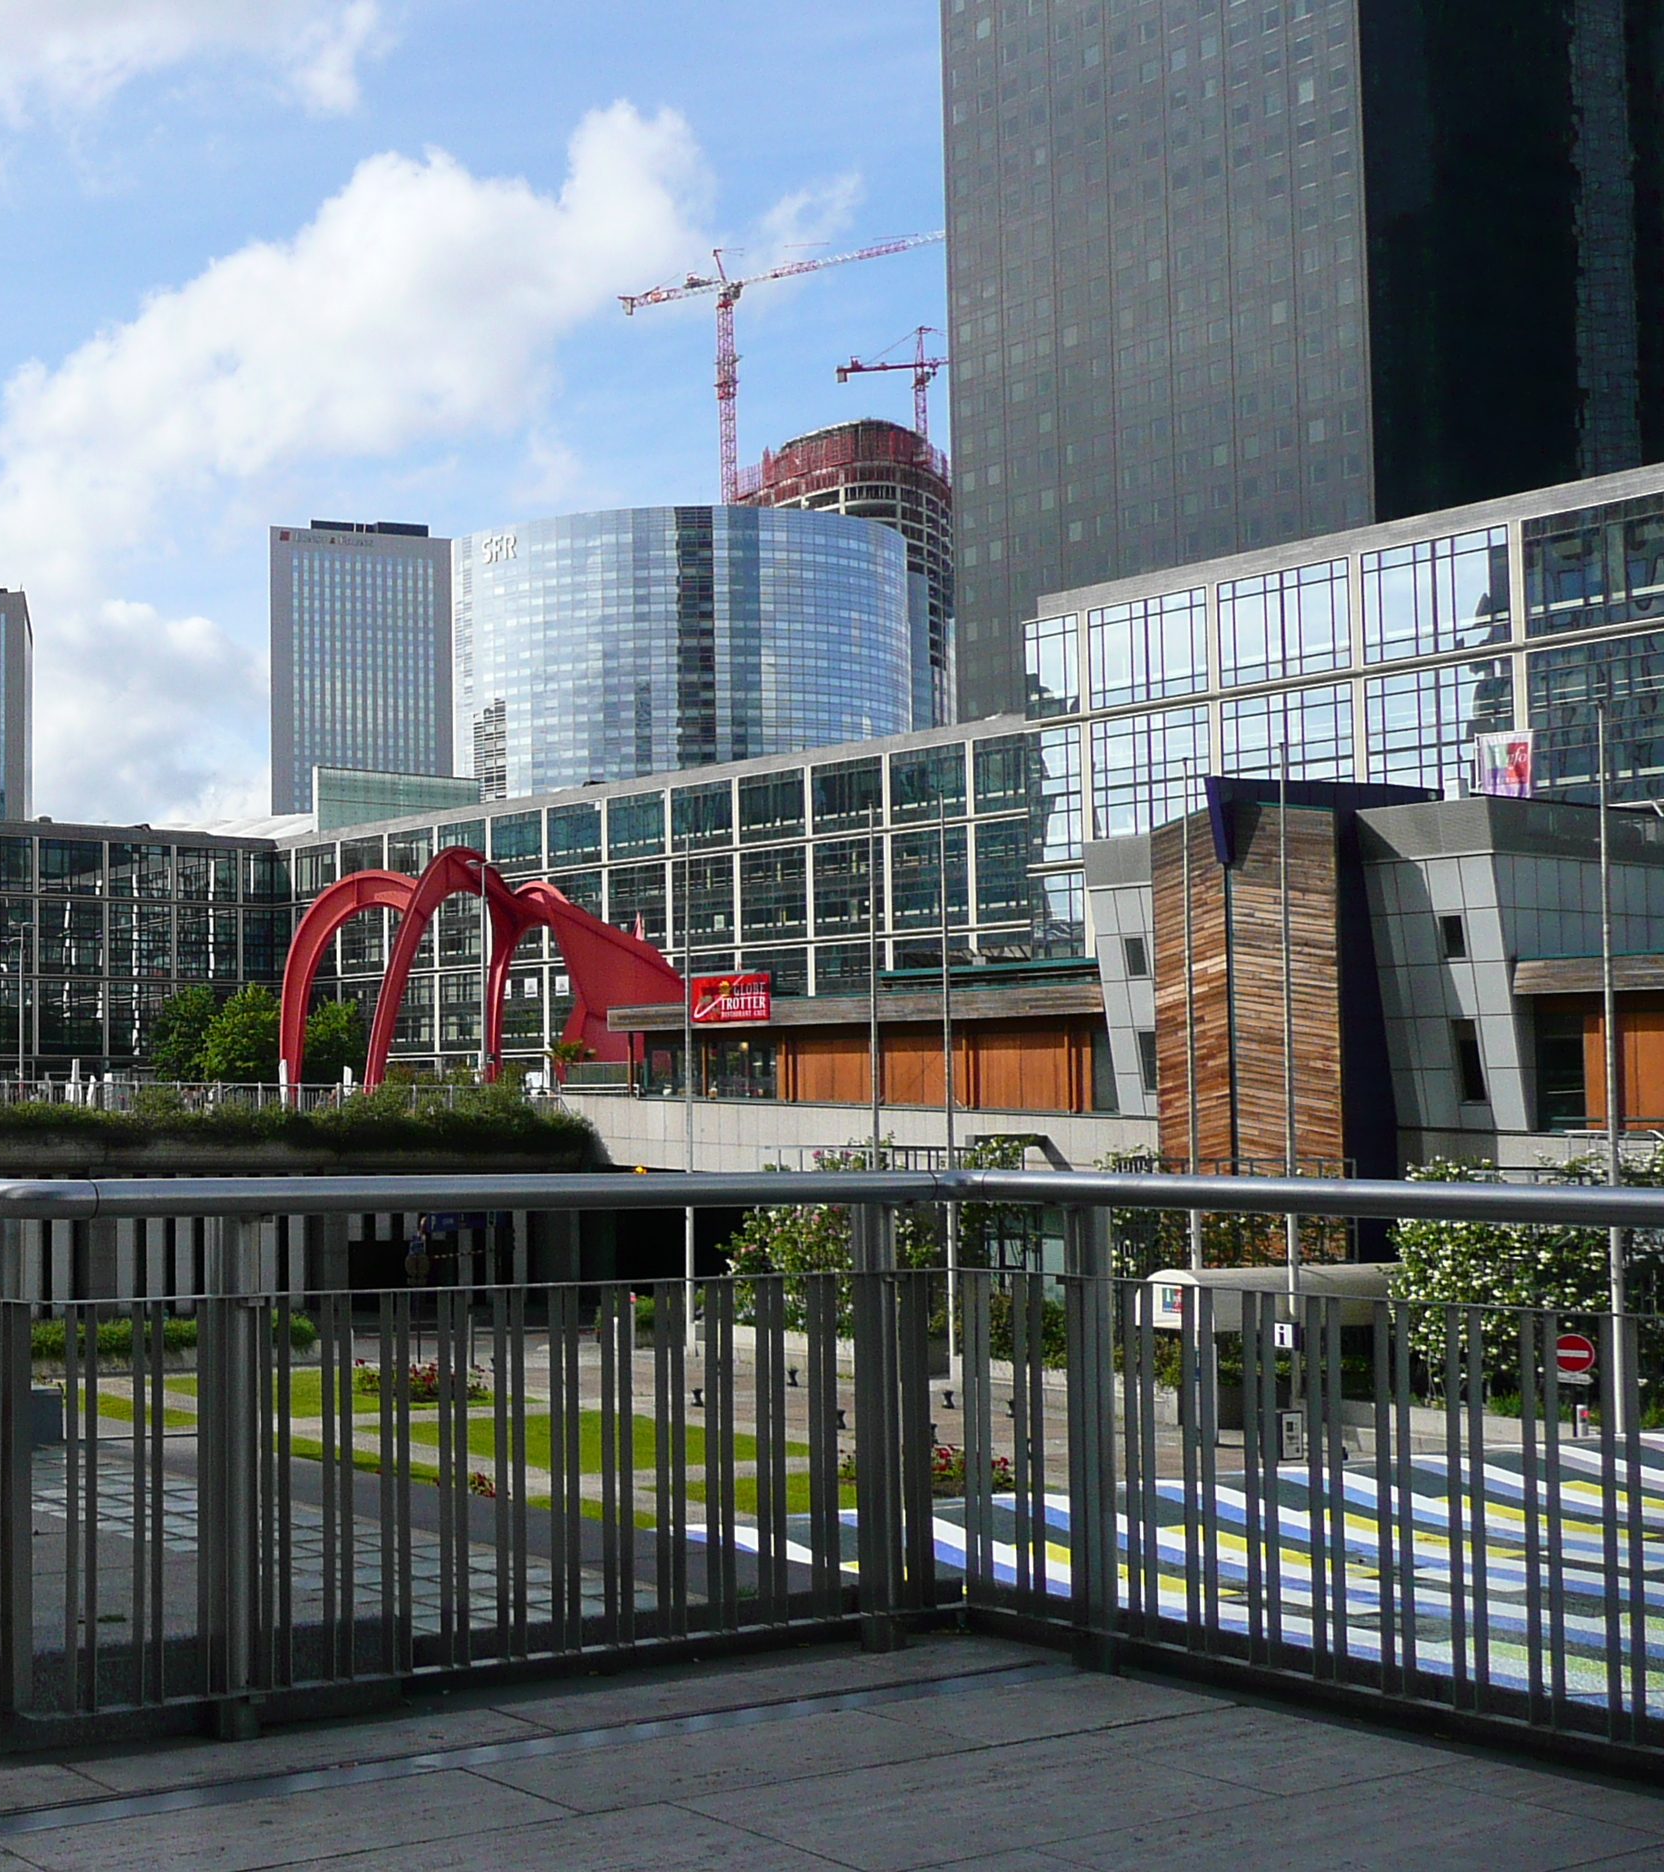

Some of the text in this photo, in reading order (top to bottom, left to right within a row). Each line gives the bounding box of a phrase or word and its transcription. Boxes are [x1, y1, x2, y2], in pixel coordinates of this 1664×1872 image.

[482, 535, 517, 564] SFR
[733, 982, 766, 996] GLOBE
[720, 996, 766, 1010] TROTTER
